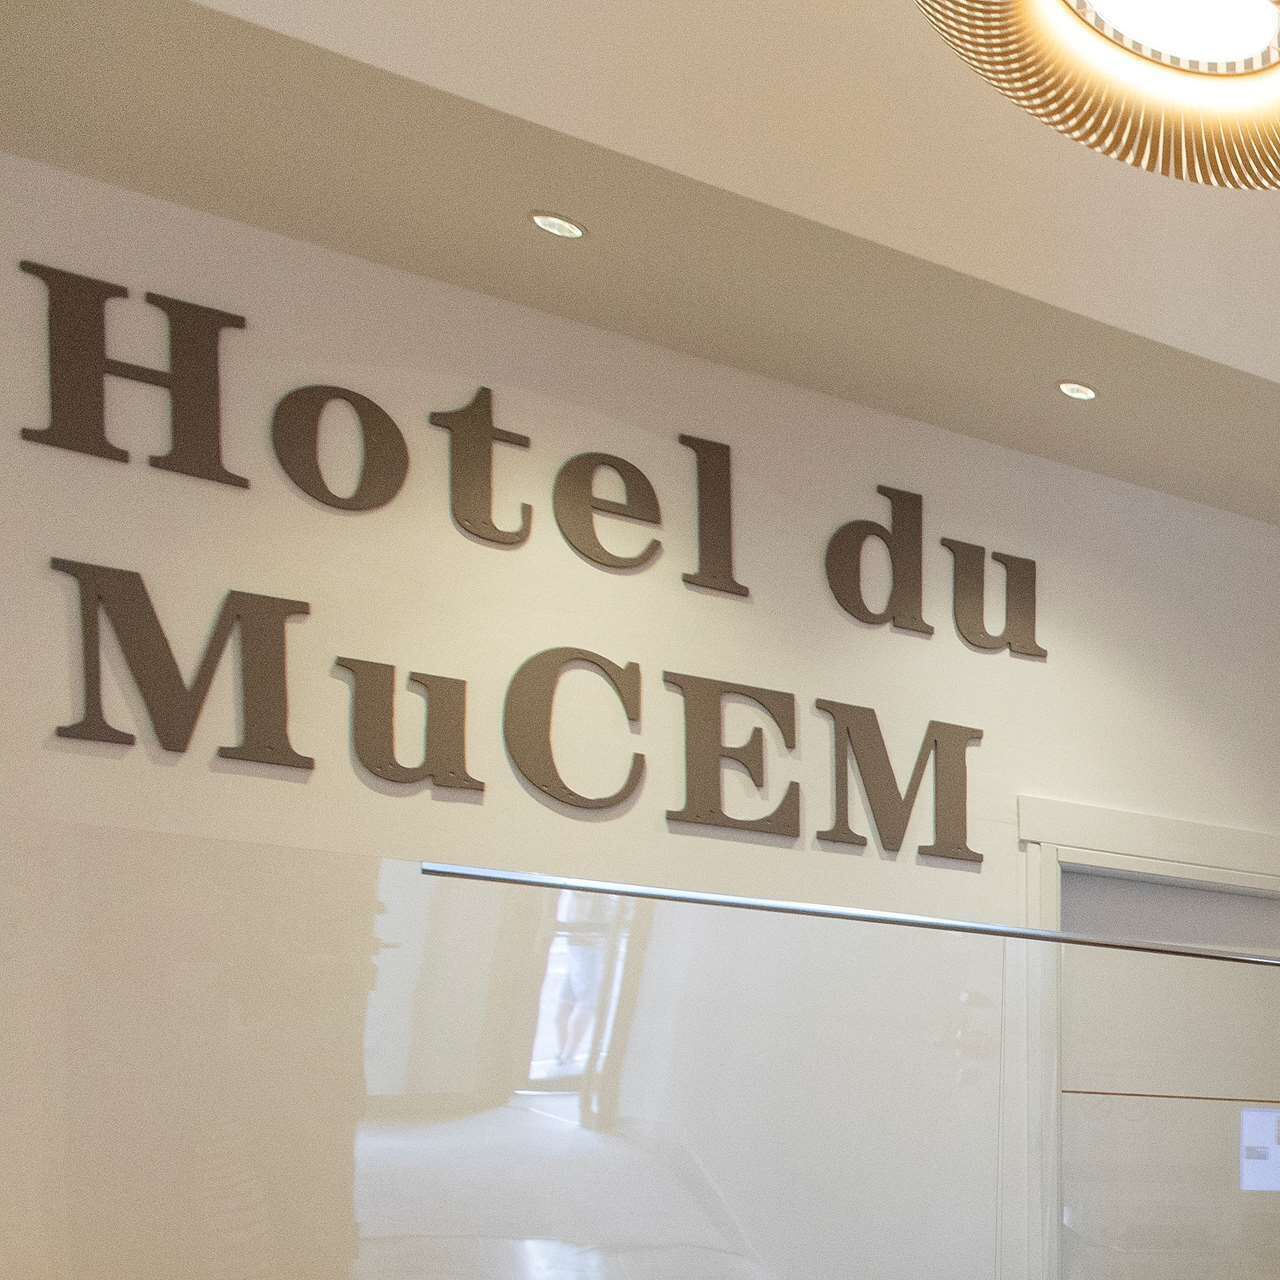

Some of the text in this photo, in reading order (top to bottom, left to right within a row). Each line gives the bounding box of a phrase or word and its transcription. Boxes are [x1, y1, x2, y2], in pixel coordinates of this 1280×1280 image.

[19, 259, 1049, 662] Hotel du
[50, 556, 984, 864] MuCEM
